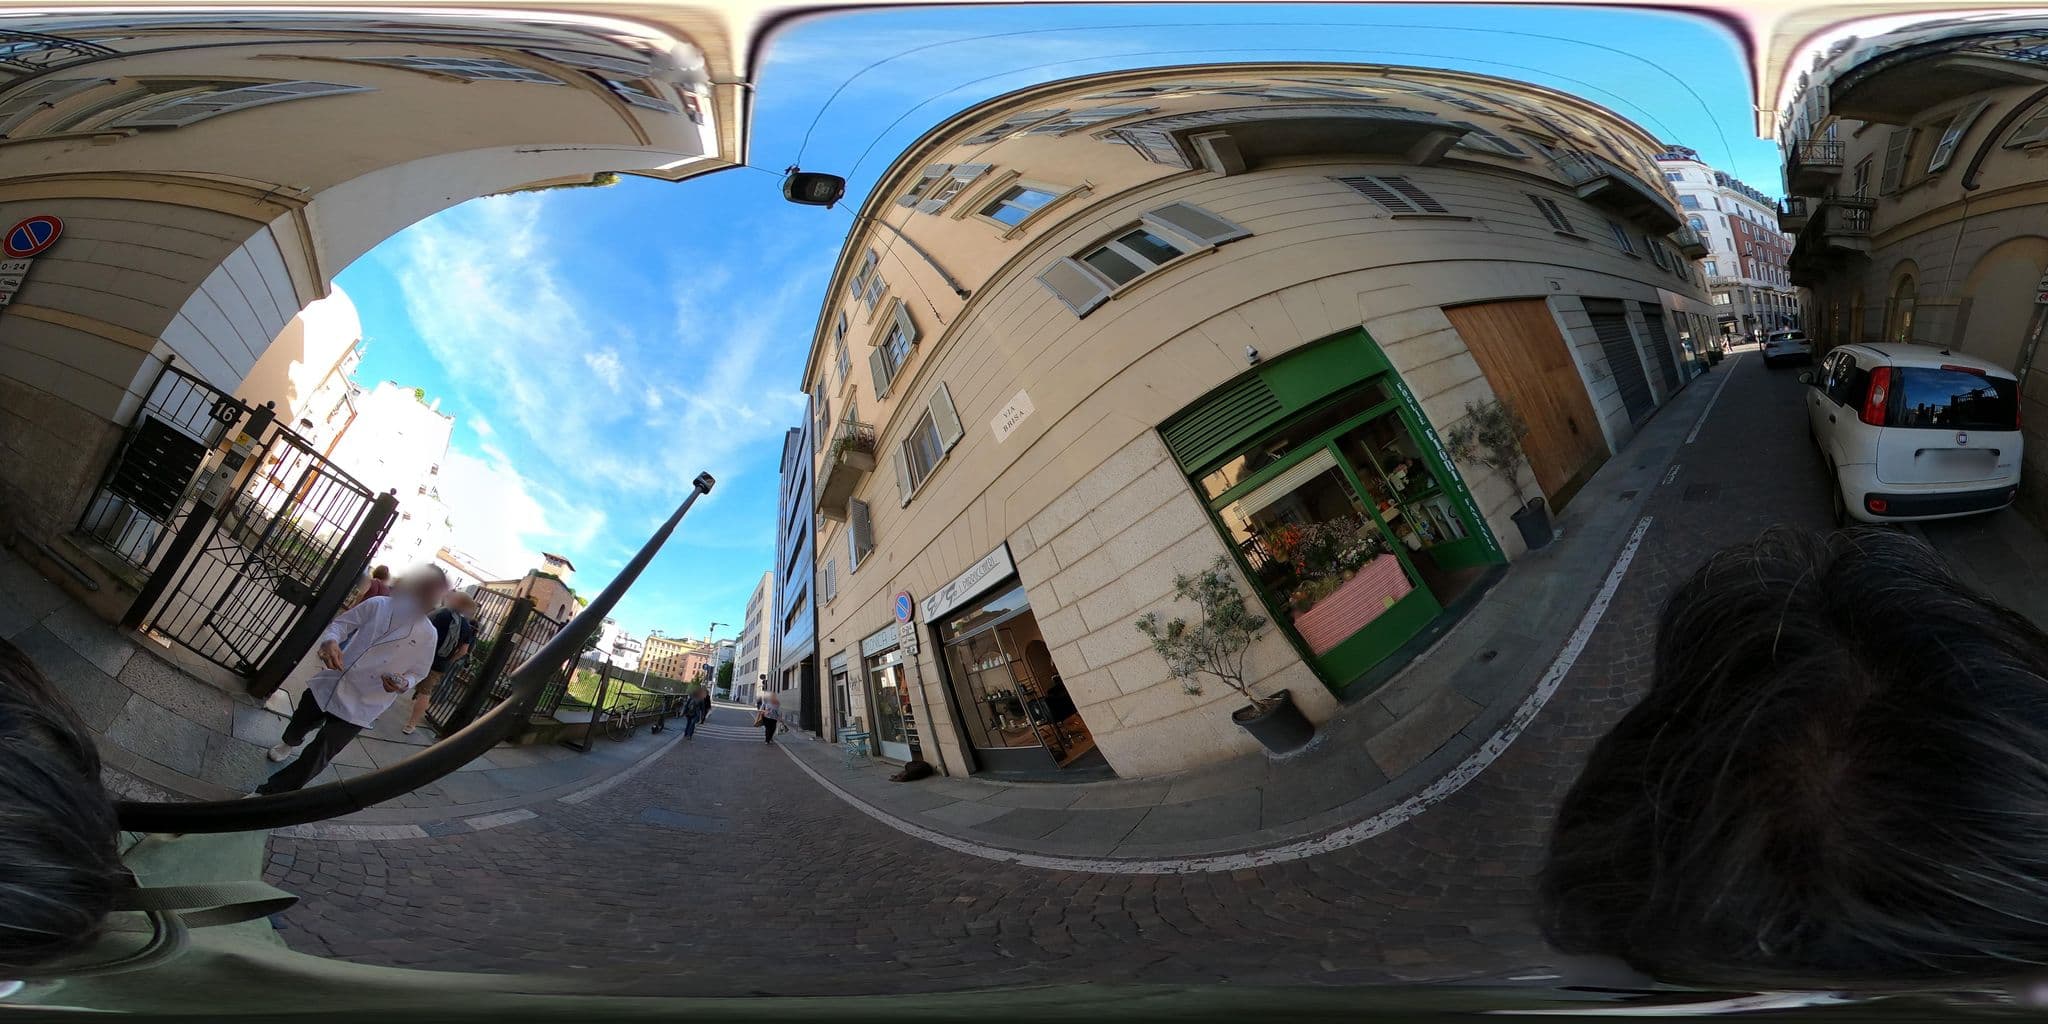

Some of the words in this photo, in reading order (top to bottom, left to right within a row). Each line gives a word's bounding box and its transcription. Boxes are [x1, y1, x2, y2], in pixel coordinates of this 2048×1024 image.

[214, 402, 236, 422] 16
[1003, 406, 1015, 418] VIA
[1003, 410, 1024, 432] BRISA
[1425, 428, 1459, 482] FIORI
